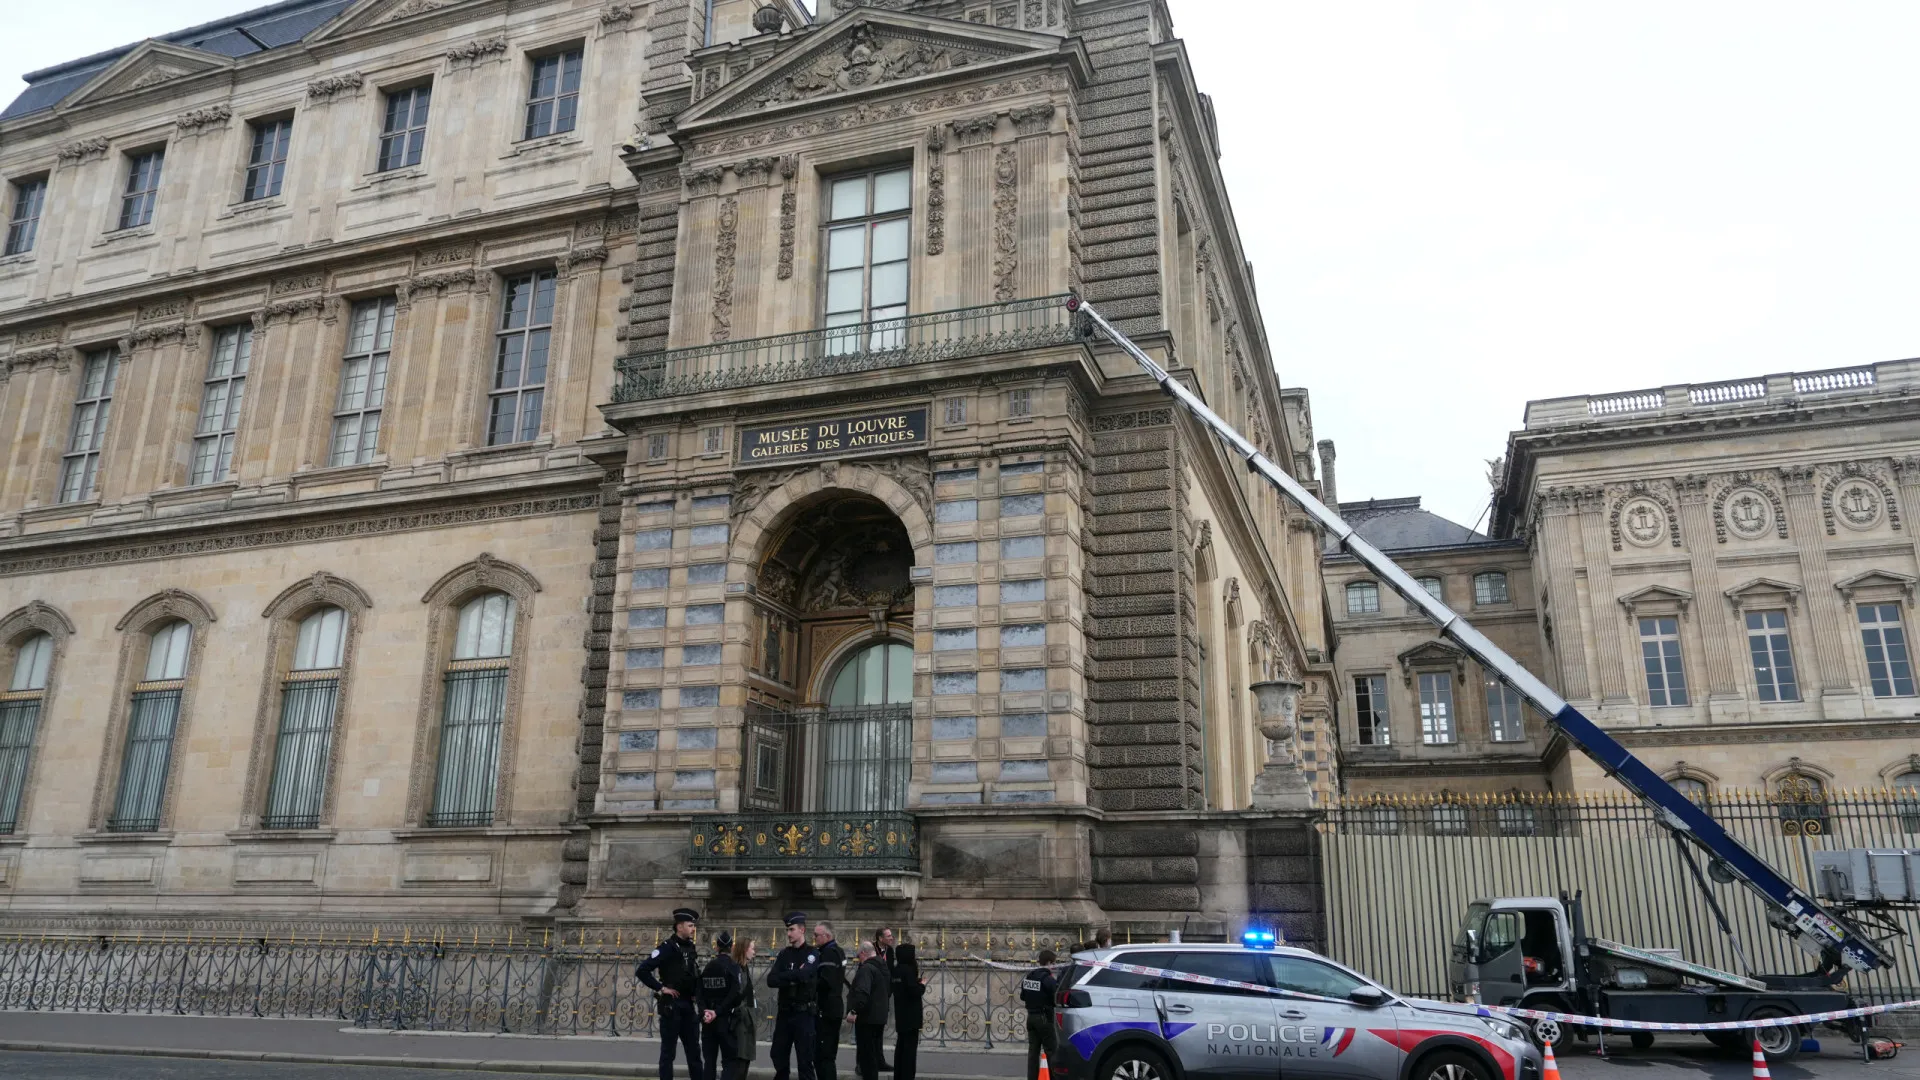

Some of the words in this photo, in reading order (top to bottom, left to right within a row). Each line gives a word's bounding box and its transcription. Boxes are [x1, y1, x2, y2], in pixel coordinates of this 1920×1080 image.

[758, 427, 810, 445] MUSÉE
[818, 423, 840, 438] DU
[847, 416, 908, 434] LOUVRE
[751, 442, 809, 458] GALERIES
[817, 439, 840, 450] DES
[849, 429, 915, 447] ANTIQUES
[1024, 980, 1040, 990] POLICE
[1206, 1023, 1318, 1044] POLICE
[1207, 1043, 1318, 1058] NATIONALE
